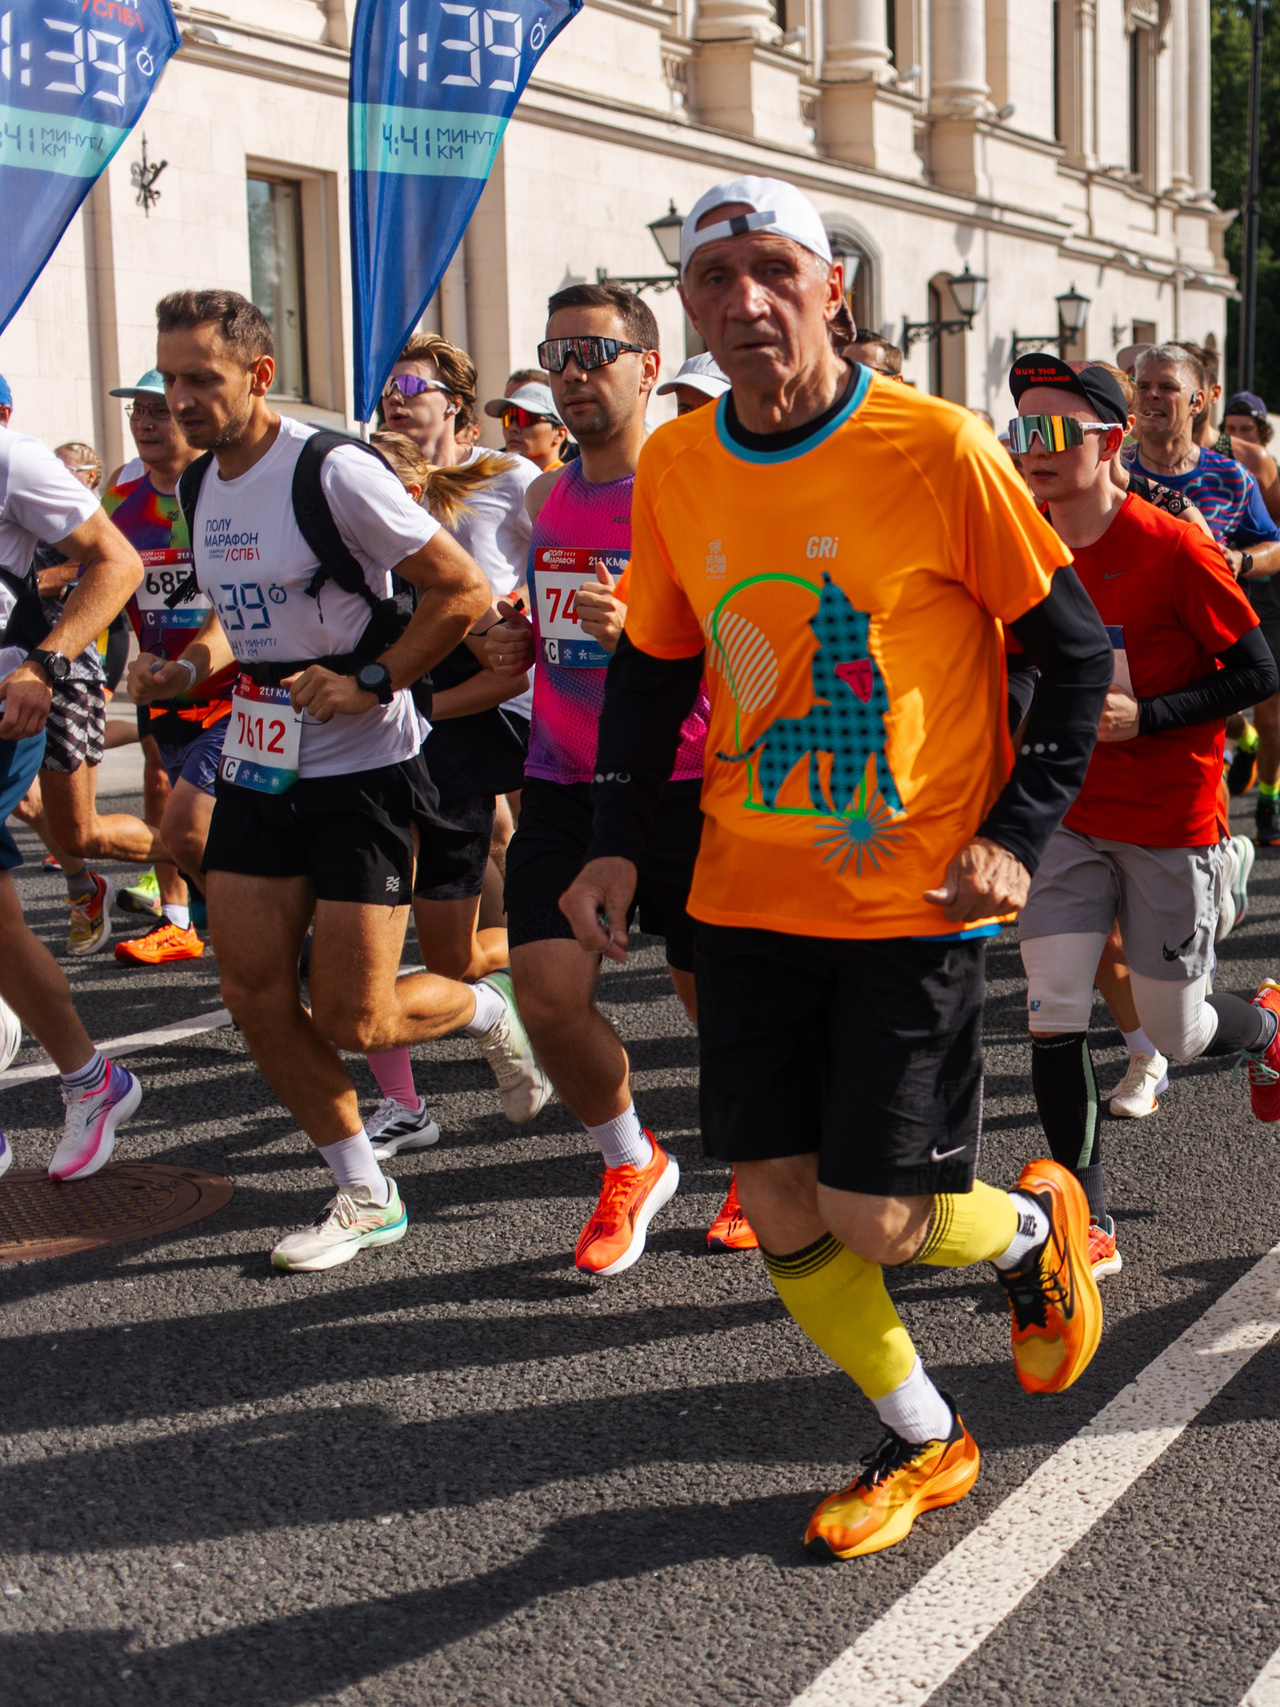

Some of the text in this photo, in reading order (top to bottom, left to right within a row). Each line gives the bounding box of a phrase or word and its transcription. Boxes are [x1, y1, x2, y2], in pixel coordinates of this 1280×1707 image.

[399, 0, 522, 92] 1:39
[41, 127, 104, 150] МИНУТ/
[383, 122, 430, 158] 4:41
[437, 127, 499, 148] МИНУТ/
[42, 143, 66, 158] КМ
[438, 145, 464, 160] КМ
[206, 519, 231, 532] ПОЛУ
[204, 532, 259, 548] МАРАФОН
[806, 536, 839, 559] GRi
[237, 711, 286, 754] 7612
